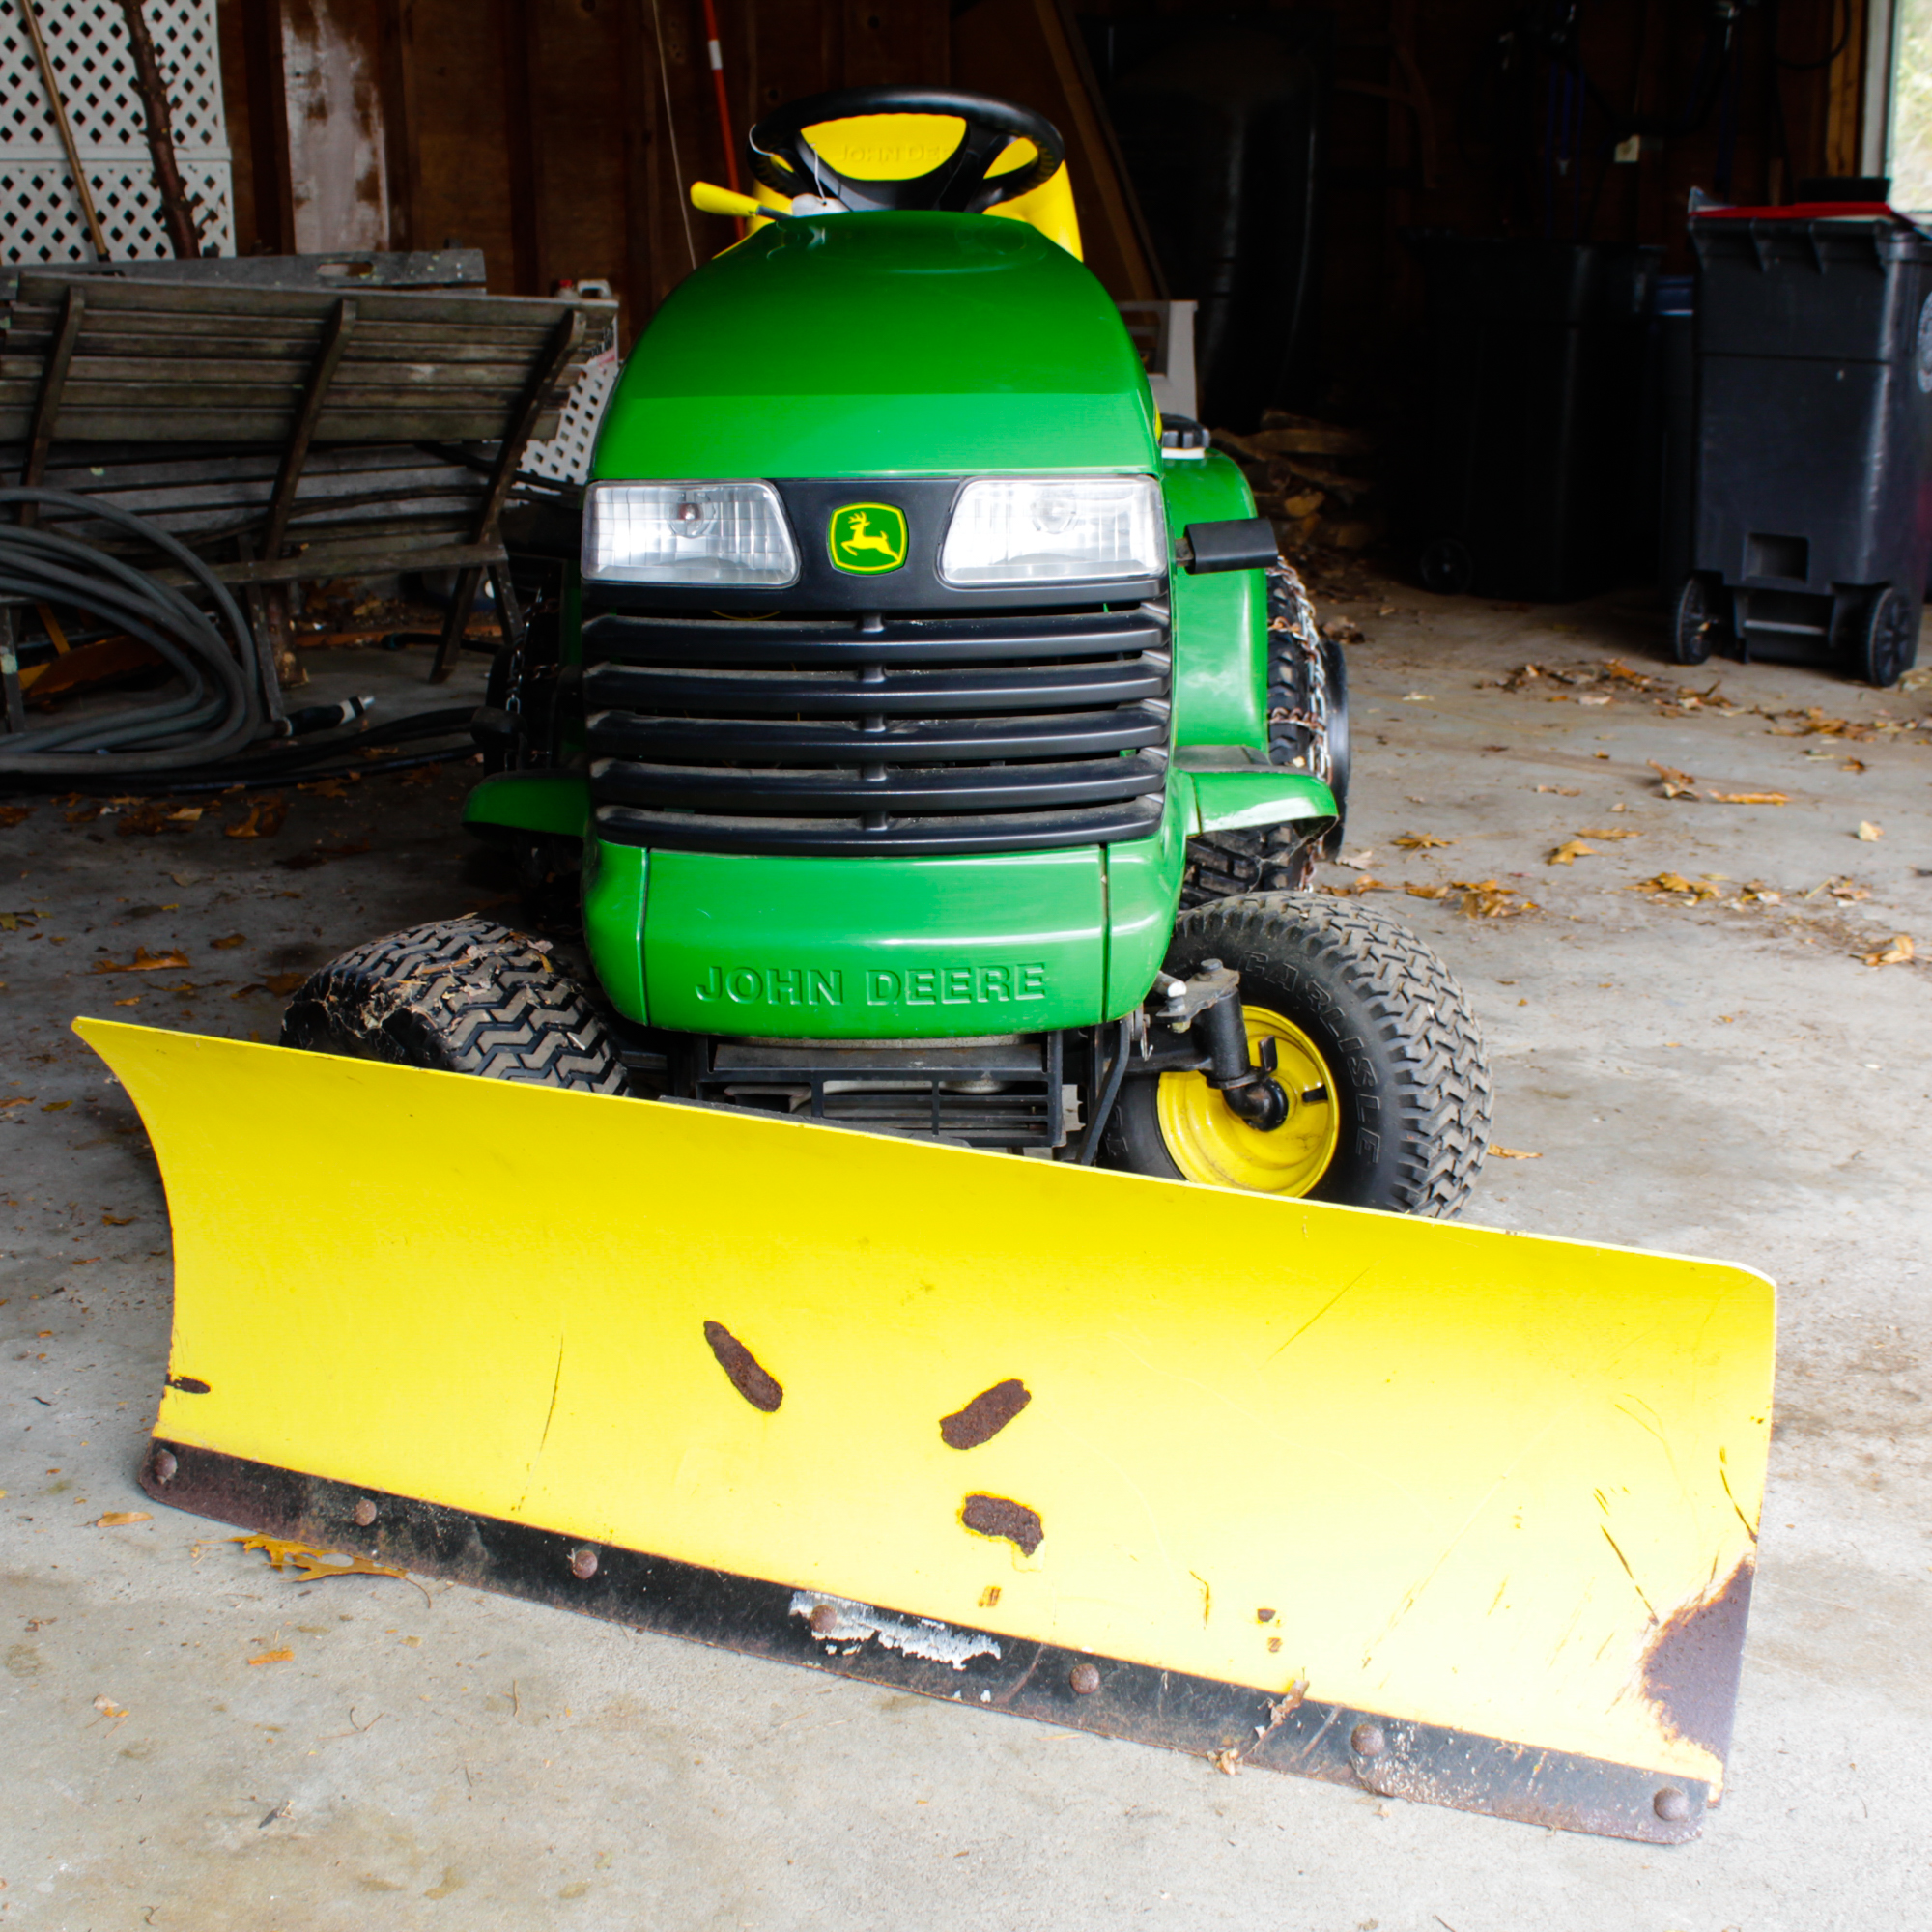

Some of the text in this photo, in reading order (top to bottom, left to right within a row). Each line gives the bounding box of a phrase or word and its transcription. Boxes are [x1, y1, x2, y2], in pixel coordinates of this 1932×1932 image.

[837, 144, 958, 163] JOHN DEE
[696, 962, 1045, 1006] JOHN DEERE
[1238, 951, 1380, 1163] CARLISLE
